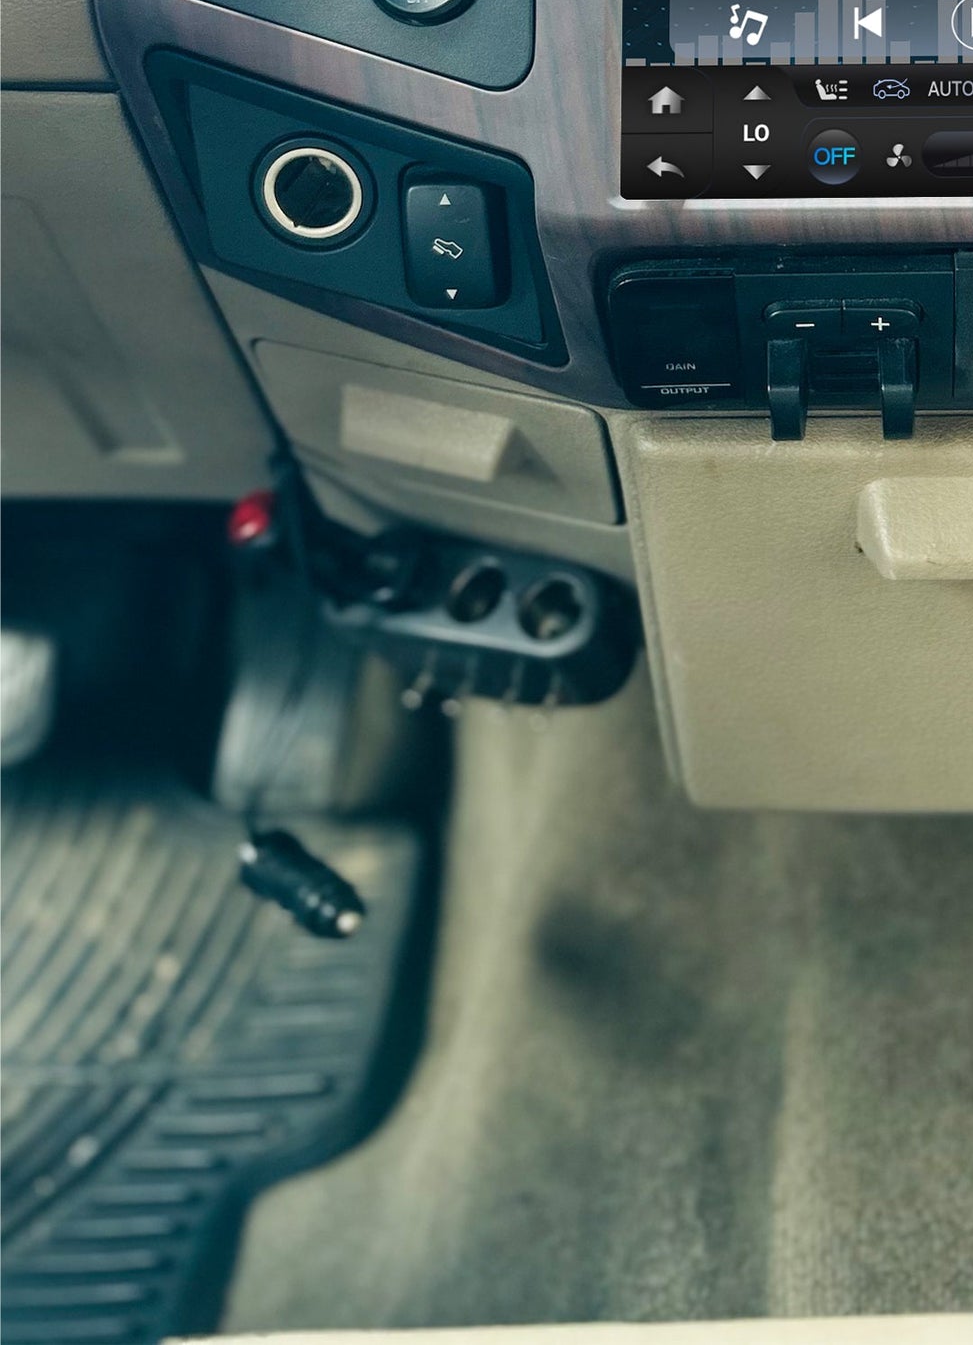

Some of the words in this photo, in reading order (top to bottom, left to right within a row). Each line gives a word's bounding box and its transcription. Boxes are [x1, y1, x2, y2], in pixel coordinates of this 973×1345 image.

[927, 81, 973, 96] AUTO
[743, 124, 769, 141] LO
[813, 148, 855, 165] OFF
[660, 386, 710, 395] OUTPUT
